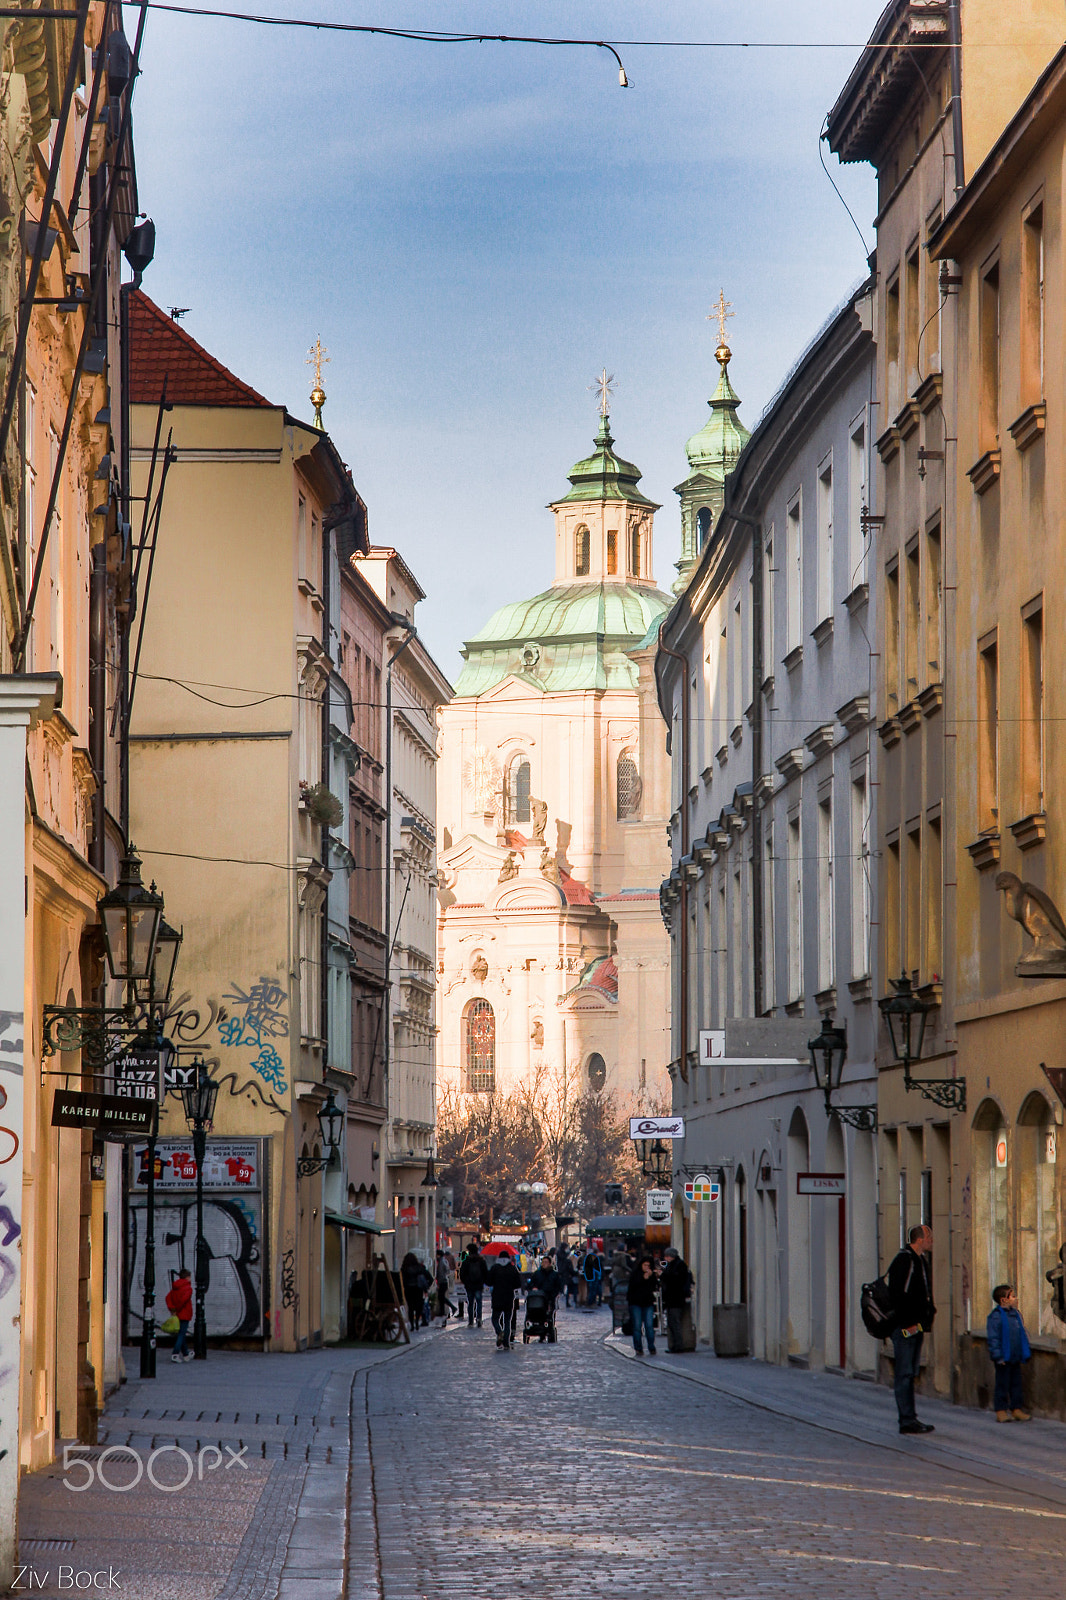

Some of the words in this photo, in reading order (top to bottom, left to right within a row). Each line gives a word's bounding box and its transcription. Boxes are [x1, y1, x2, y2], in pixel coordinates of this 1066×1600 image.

[705, 1038, 725, 1058] L
[116, 1071, 156, 1086] JAZZ
[116, 1086, 156, 1100] CLUB
[61, 1105, 100, 1117] KAREN
[104, 1109, 146, 1122] MILLEN
[239, 1169, 249, 1178] 99
